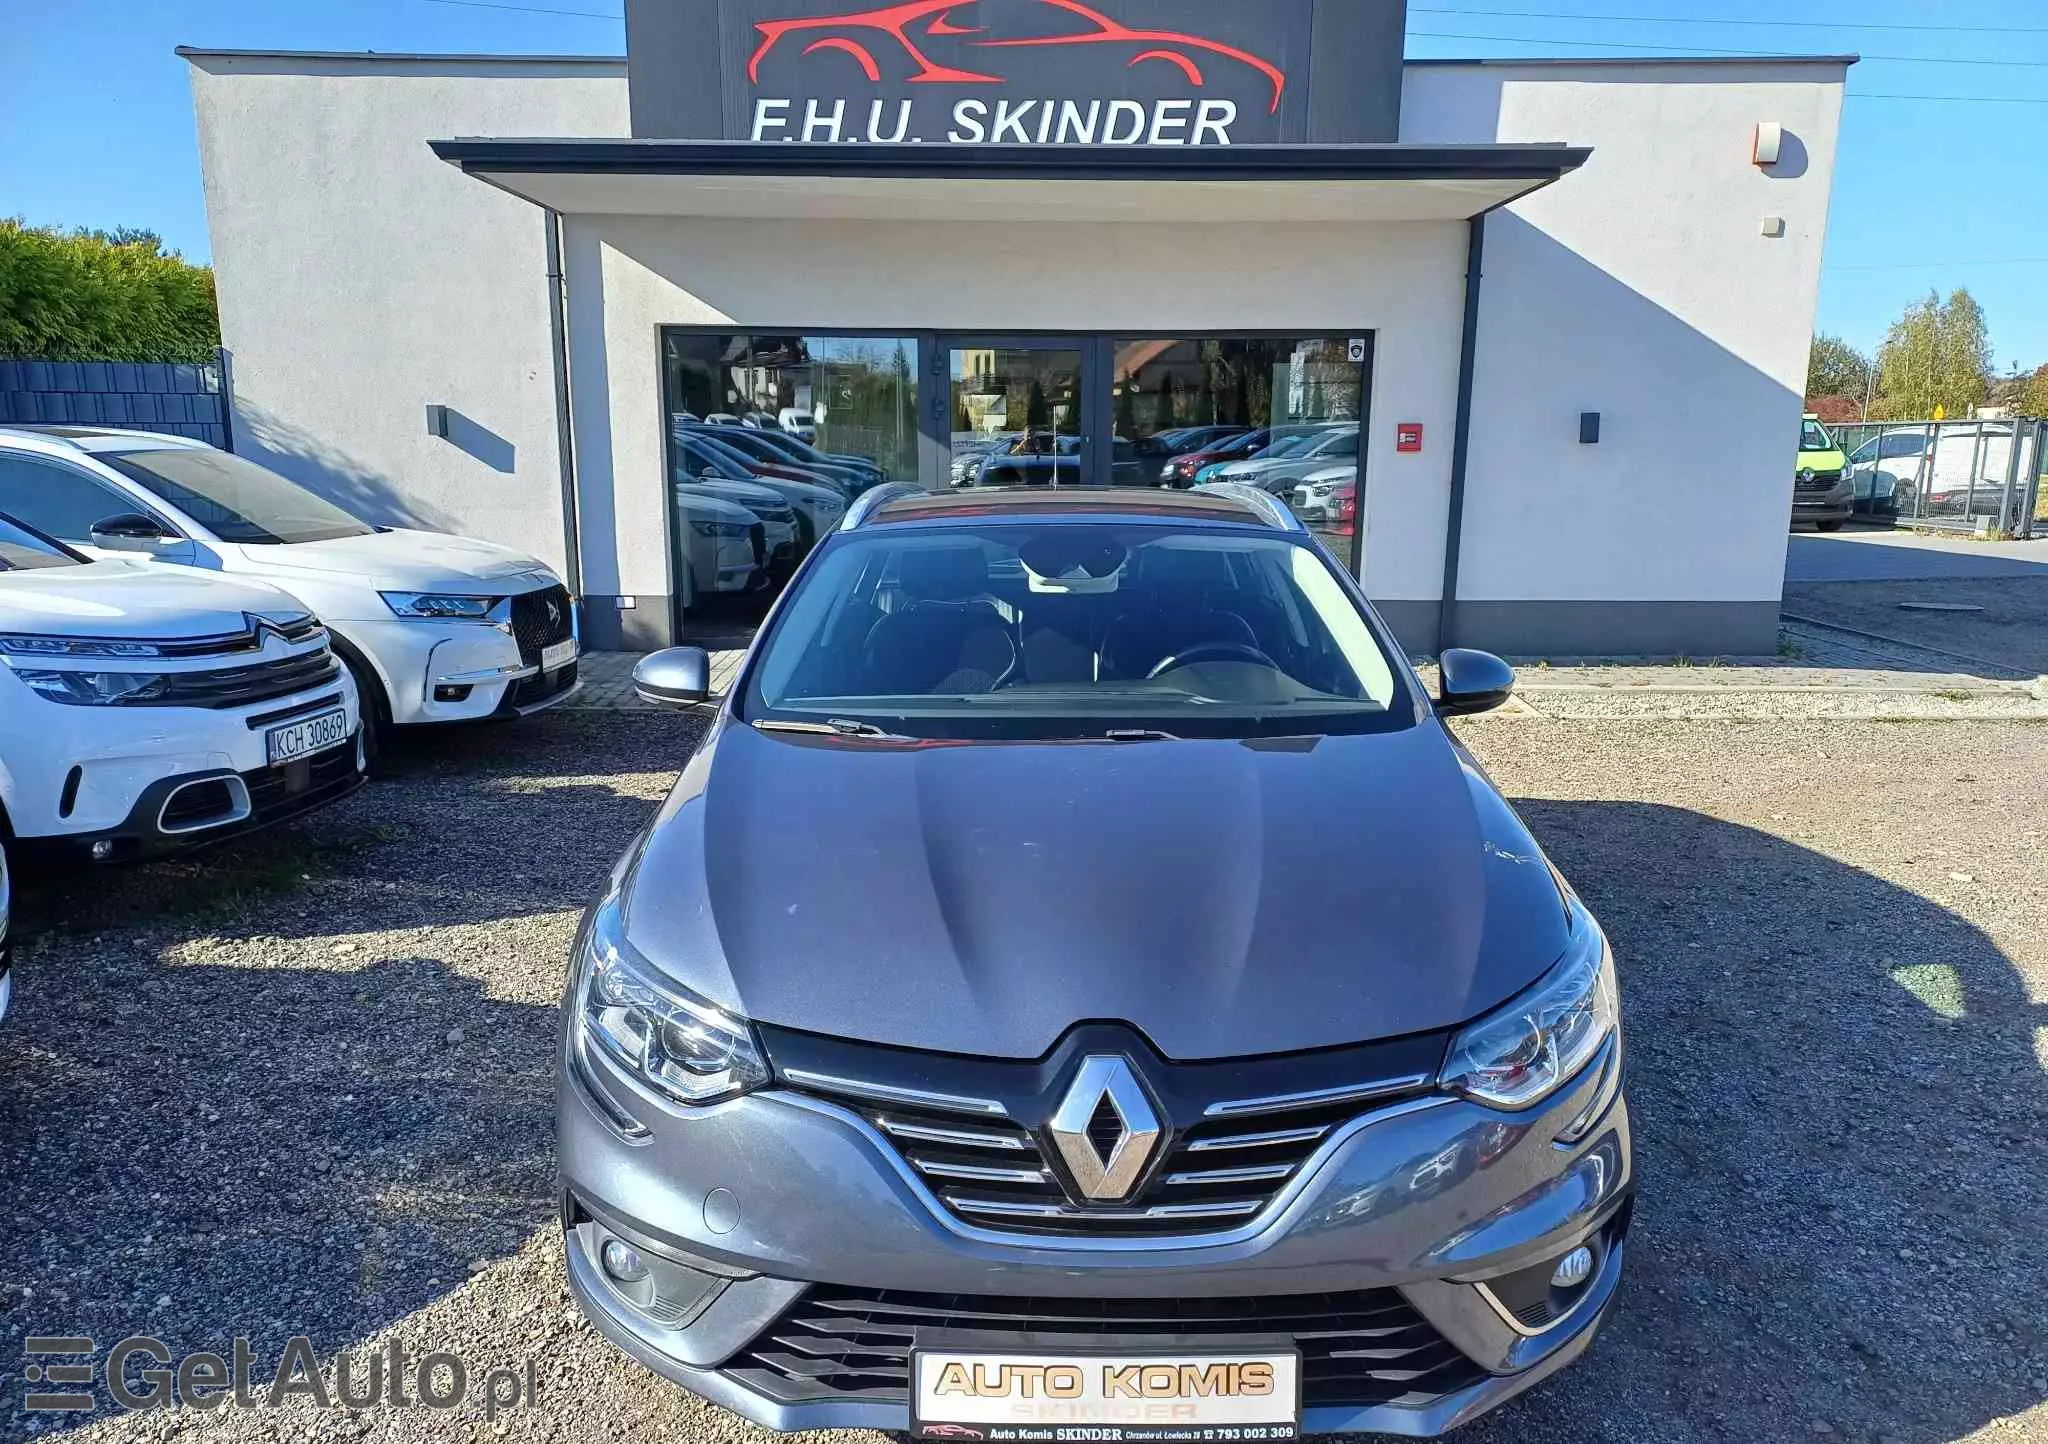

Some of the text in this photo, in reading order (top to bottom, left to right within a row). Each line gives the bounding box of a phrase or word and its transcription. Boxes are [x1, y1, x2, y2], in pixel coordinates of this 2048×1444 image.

[750, 99, 1237, 145] F.H.U. SKINDER
[276, 727, 304, 757] KCH
[307, 715, 343, 747] 30869
[933, 1362, 1275, 1399] AUTO KOMIS
[989, 1428, 1016, 1440] Auto
[1018, 1428, 1053, 1440] Komis
[1056, 1427, 1123, 1441] SKINDER
[1216, 1428, 1240, 1439] 793
[1243, 1428, 1267, 1438] 002
[1270, 1427, 1294, 1438] 309
